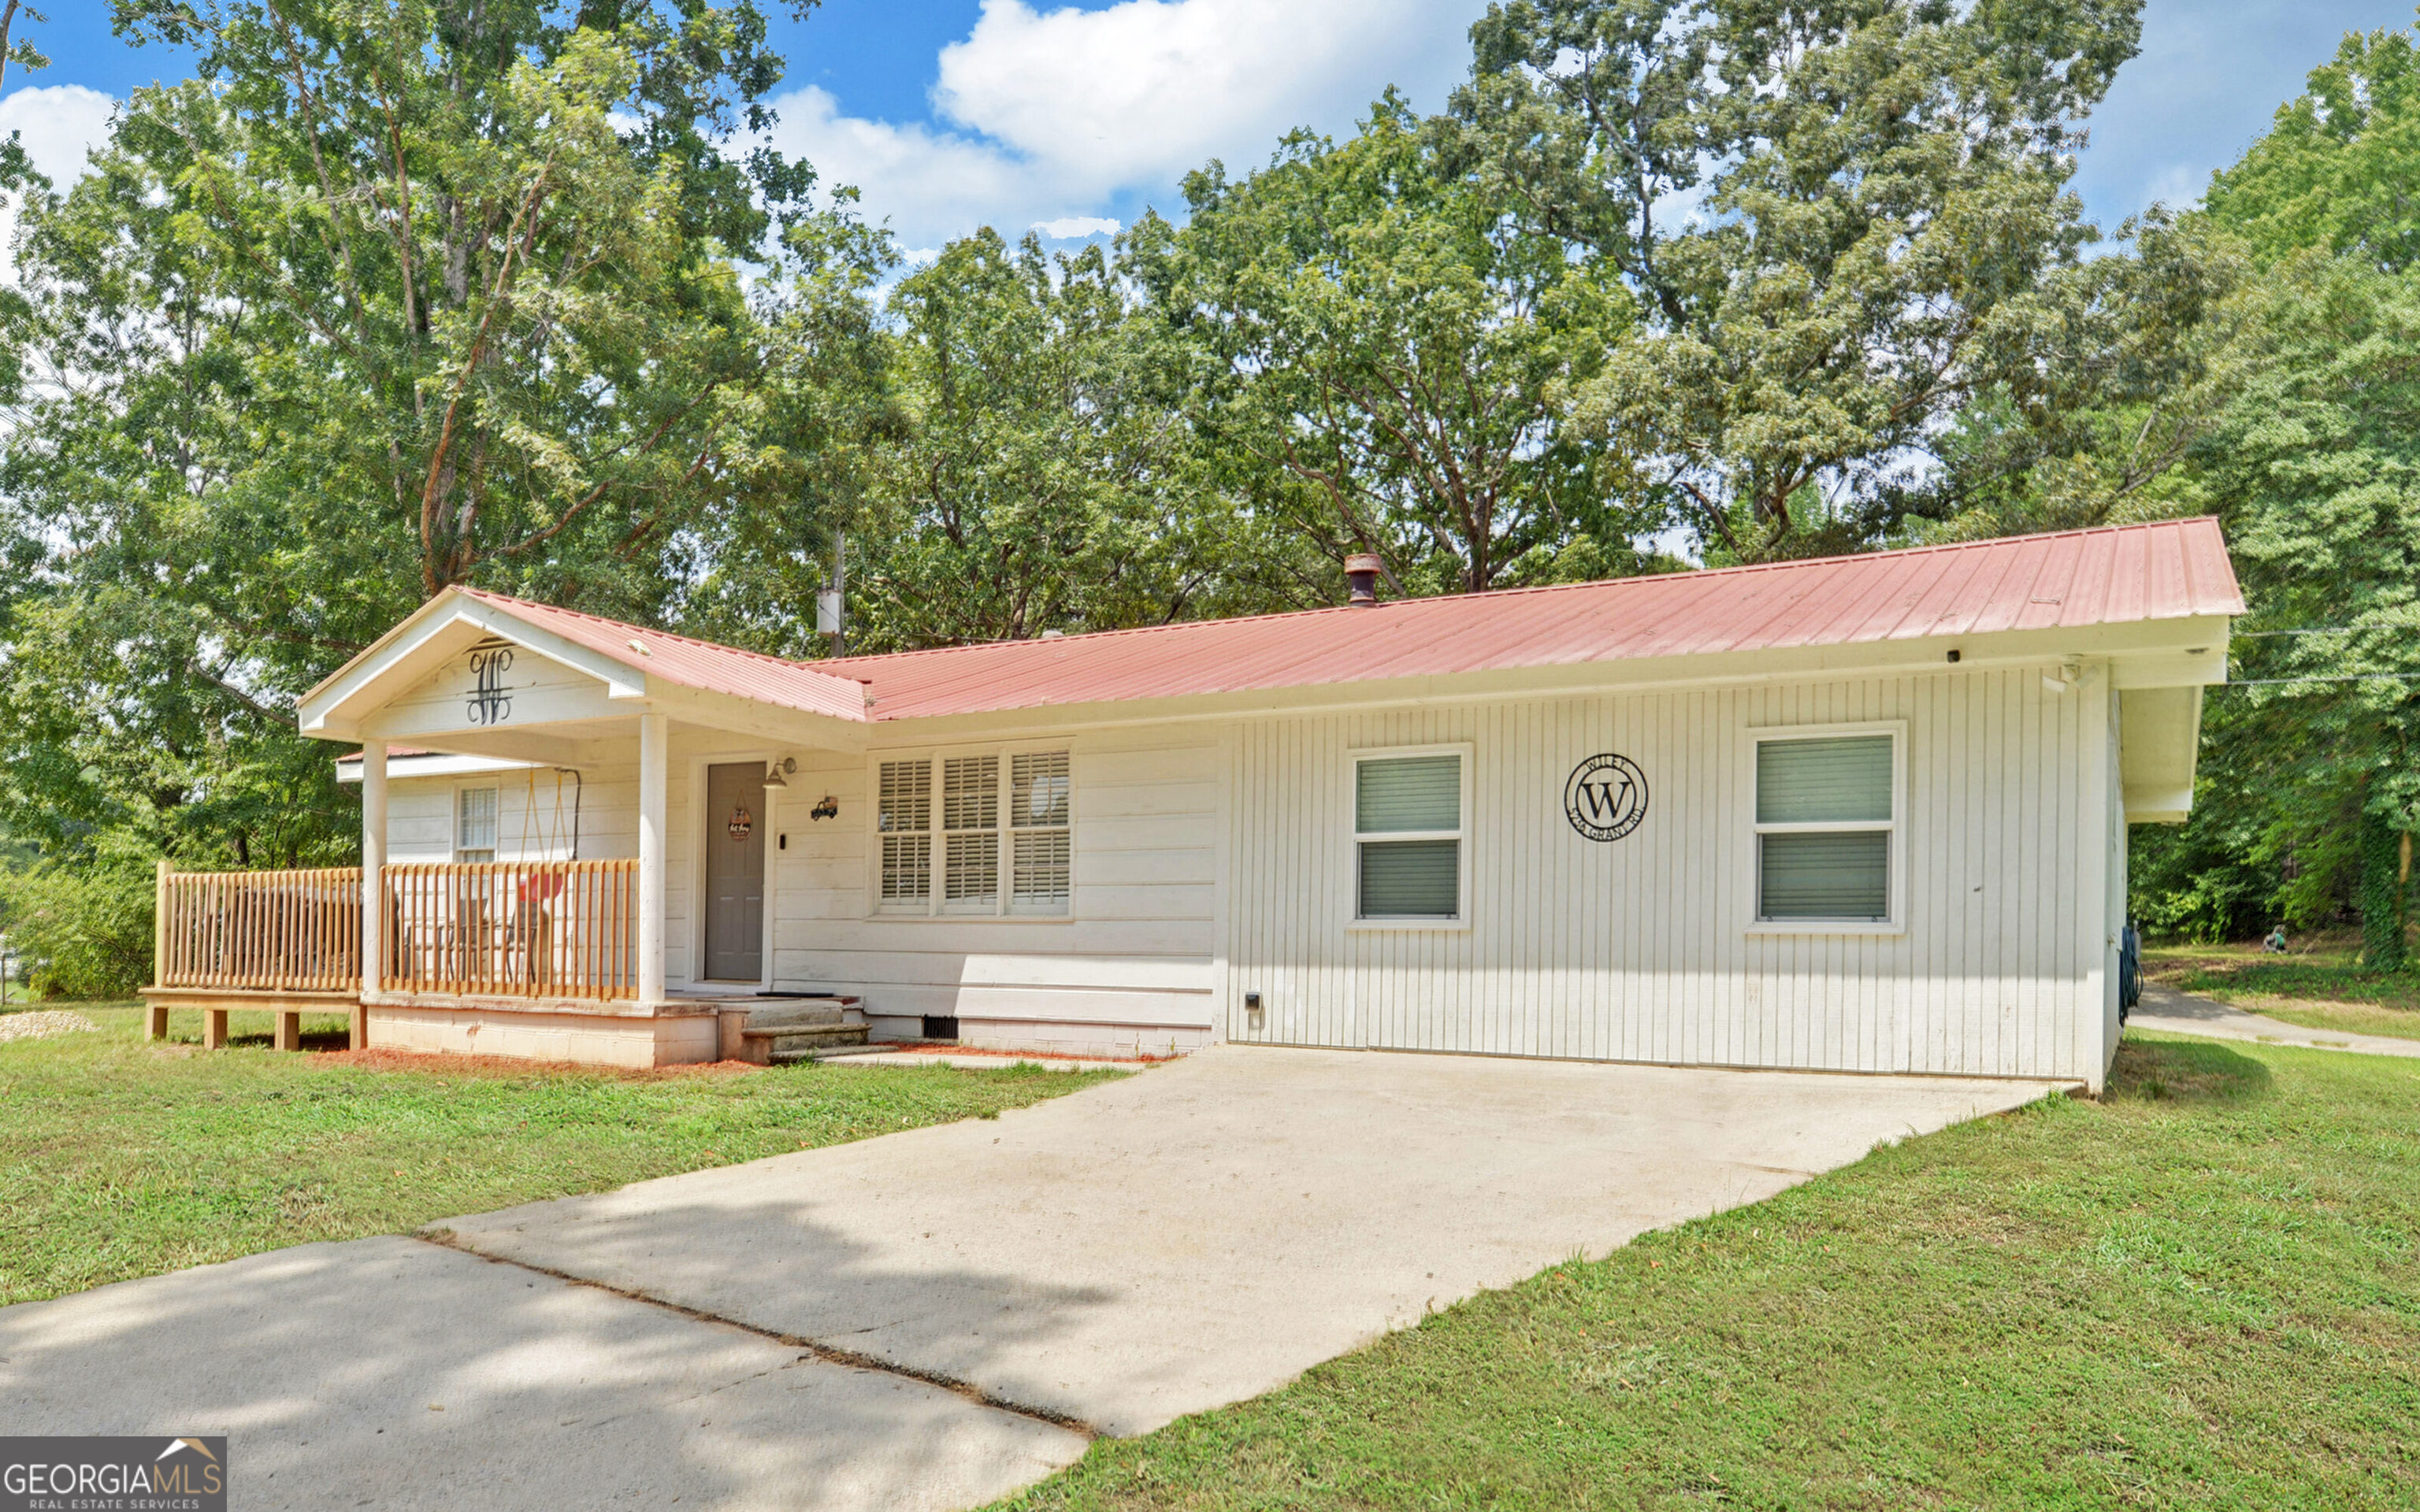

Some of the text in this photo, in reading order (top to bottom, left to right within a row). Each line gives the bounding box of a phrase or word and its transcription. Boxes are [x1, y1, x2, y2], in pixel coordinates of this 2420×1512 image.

[1586, 756, 1626, 772] WILEY
[1580, 781, 1631, 817] W
[1589, 821, 1628, 841] GRANT
